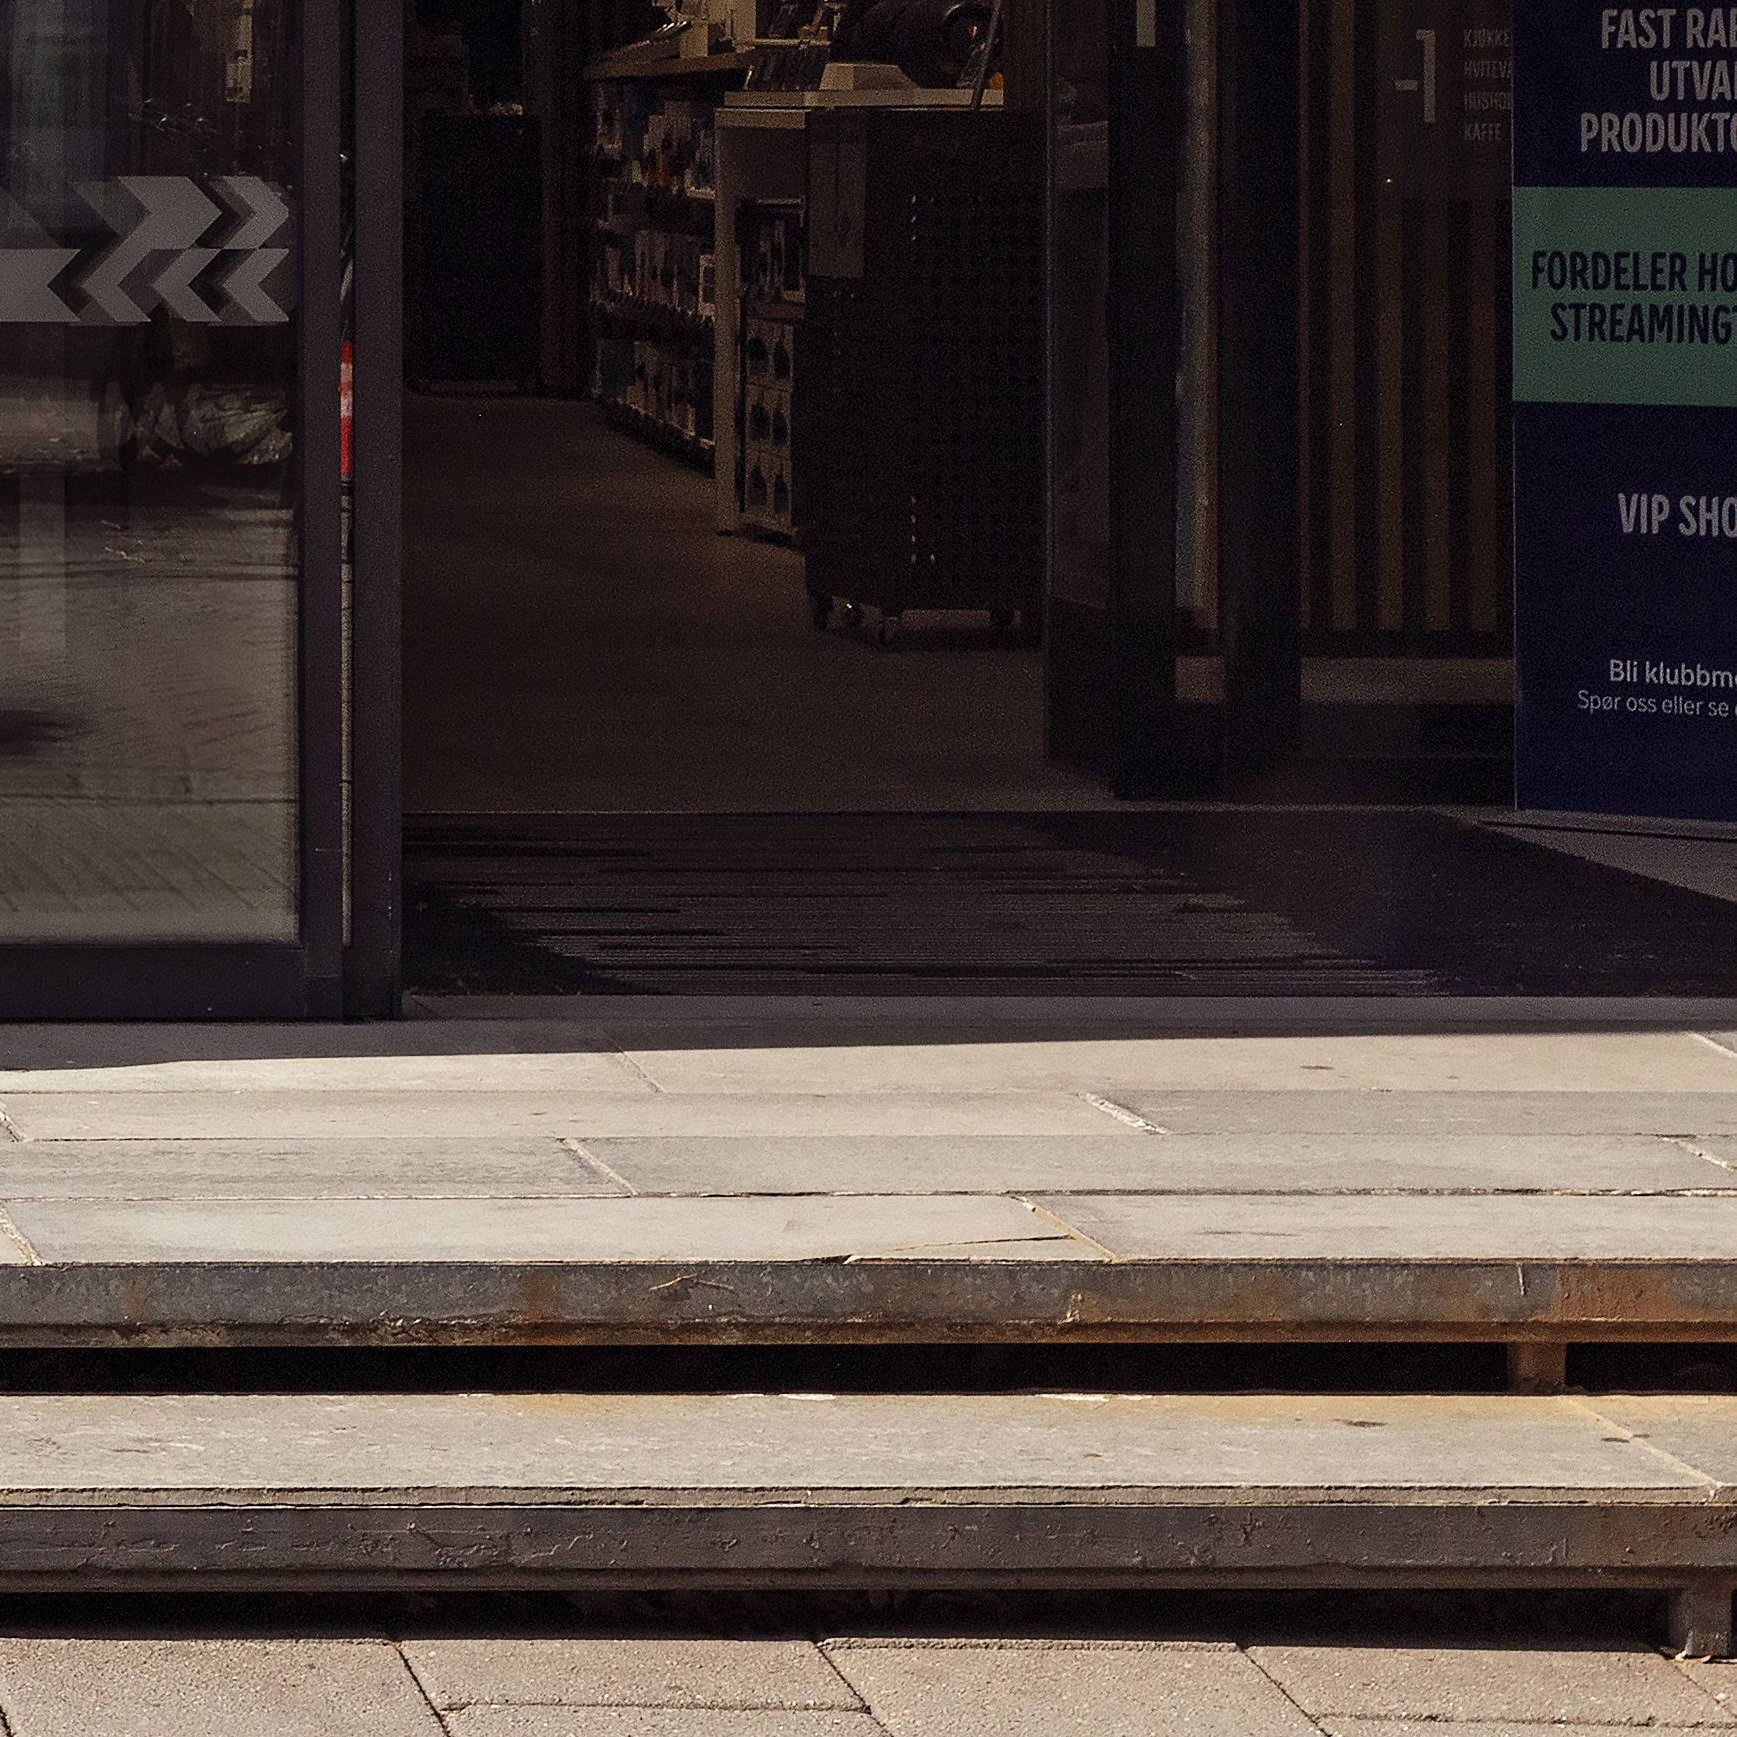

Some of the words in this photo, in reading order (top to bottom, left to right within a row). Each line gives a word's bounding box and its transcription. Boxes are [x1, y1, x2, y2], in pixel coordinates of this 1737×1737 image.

[1601, 7, 1677, 49] FAST
[1650, 59, 1737, 101] UTVA
[1463, 122, 1502, 142] KAFFE
[1532, 250, 1687, 292] FORDELER
[1550, 302, 1737, 345] STREAMING
[1618, 492, 1670, 534] VIP
[1610, 658, 1638, 684] Bli
[1645, 660, 1737, 689] klubbm
[1577, 689, 1621, 714] Spør
[1626, 696, 1658, 713] oss
[1661, 694, 1704, 715] eller
[1708, 701, 1730, 718] se
